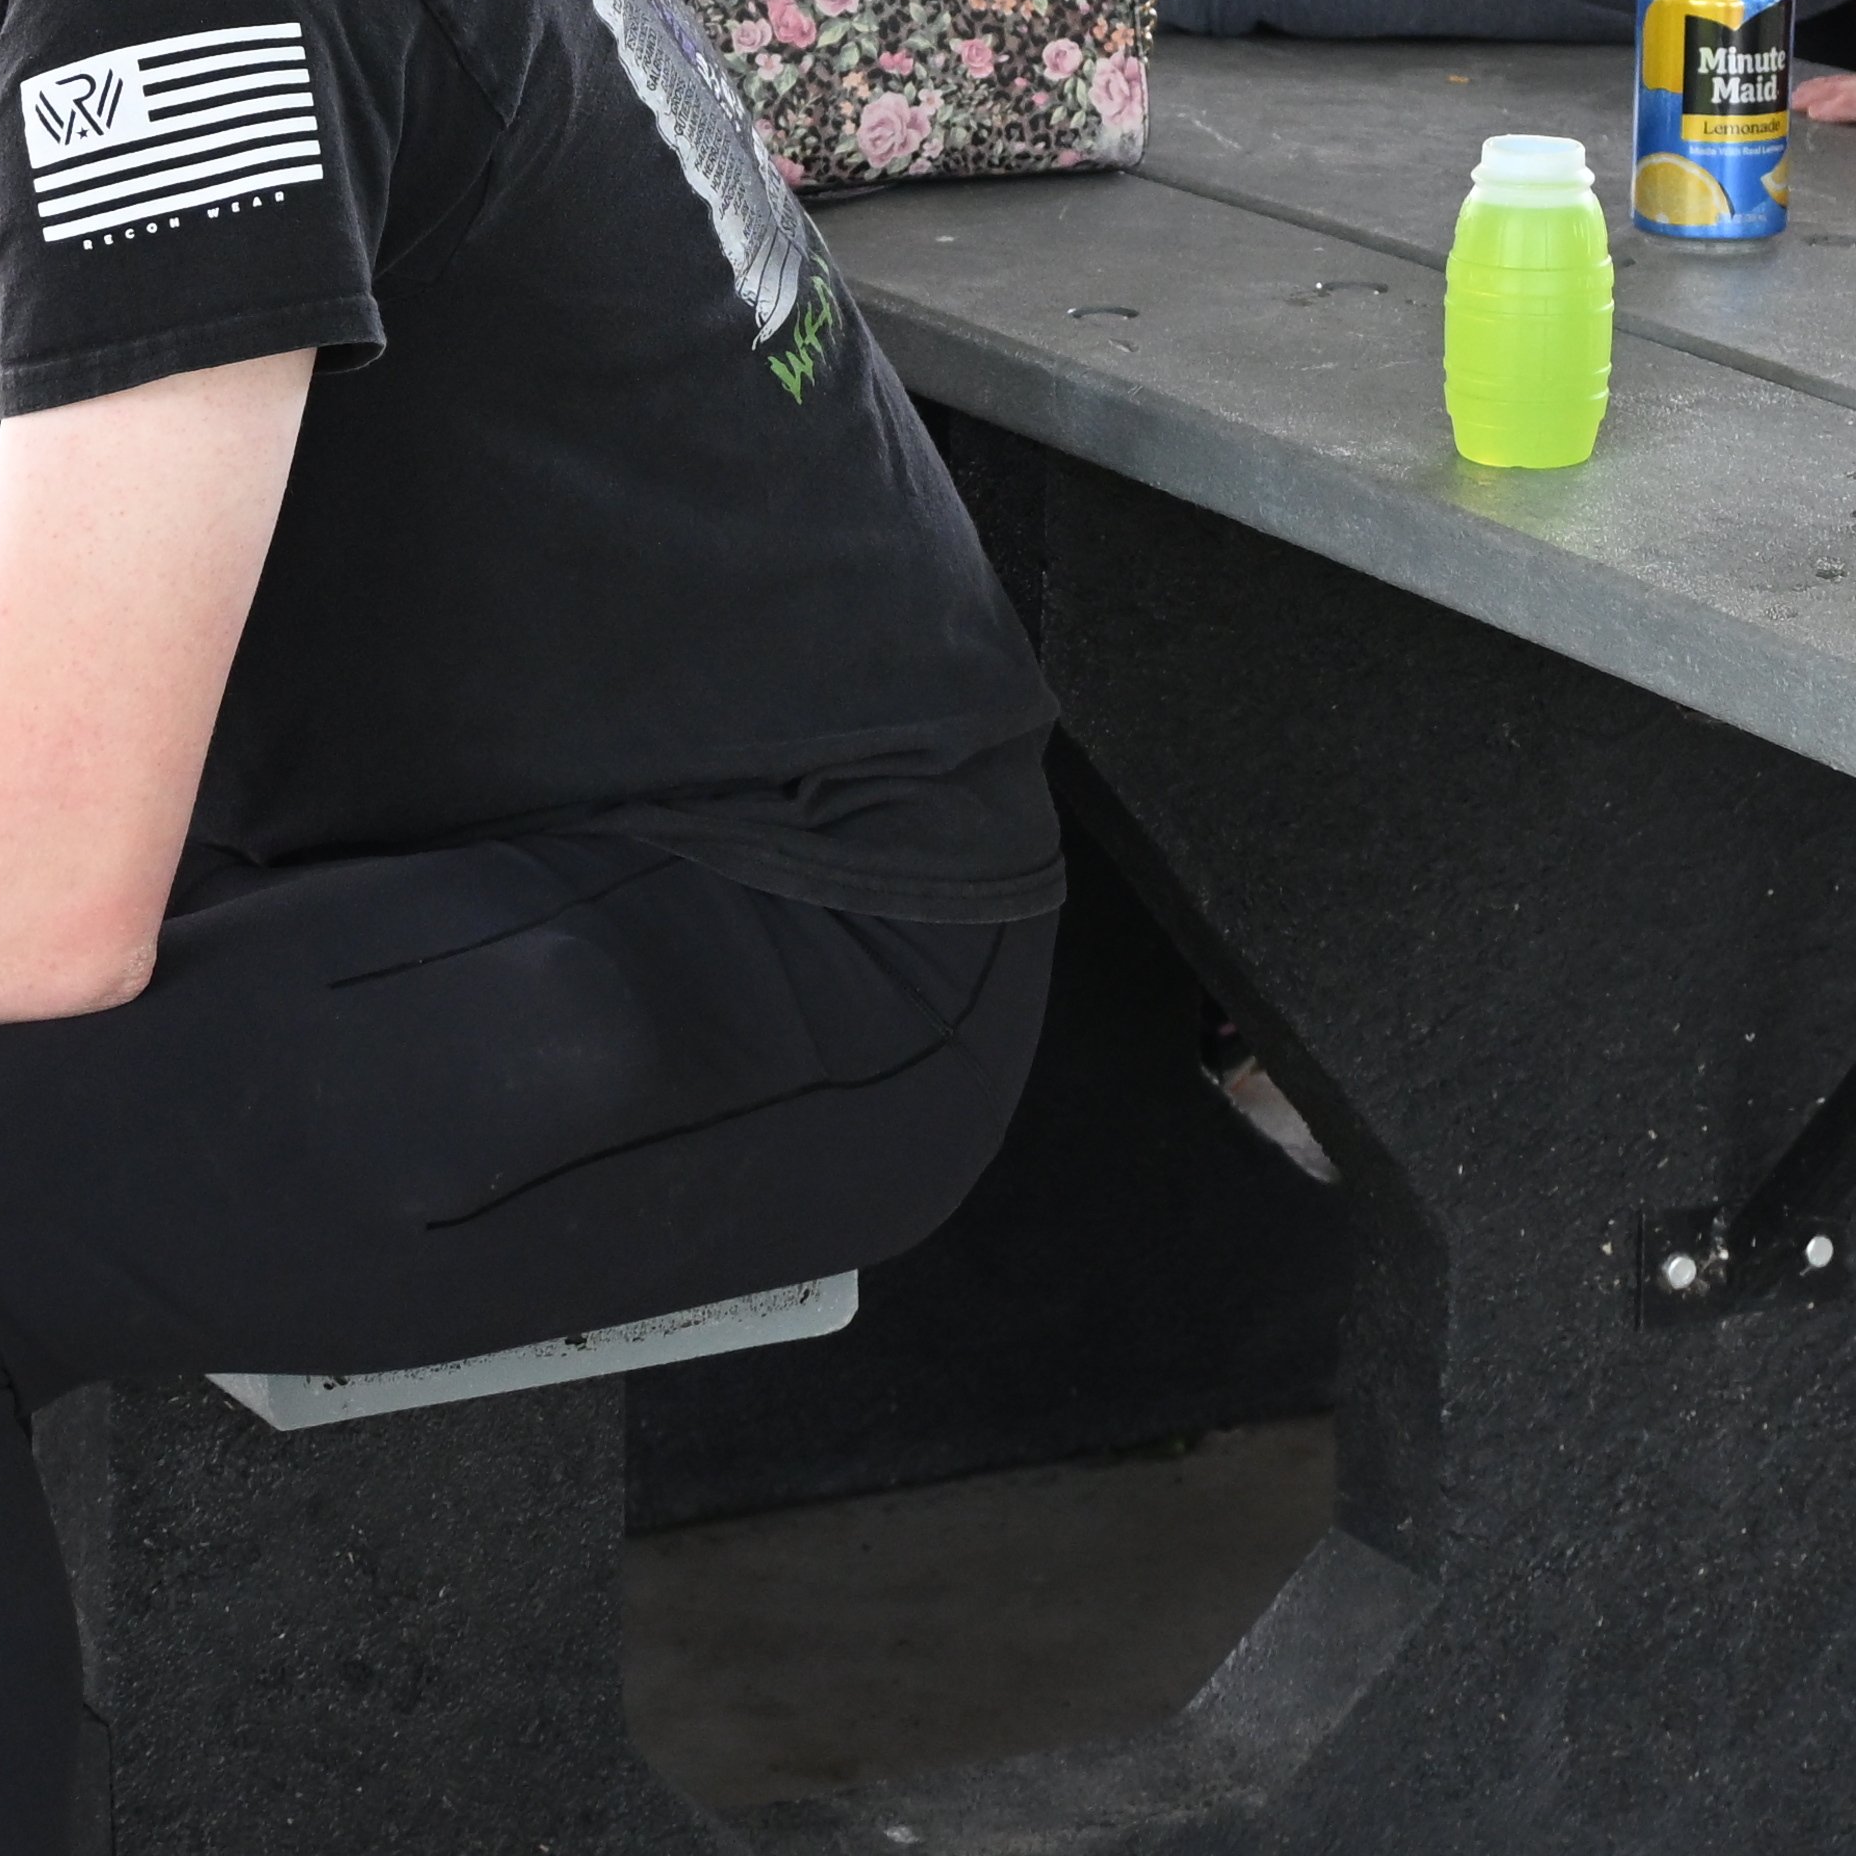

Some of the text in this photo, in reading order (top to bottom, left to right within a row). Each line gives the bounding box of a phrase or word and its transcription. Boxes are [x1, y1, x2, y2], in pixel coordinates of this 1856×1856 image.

[1697, 46, 1787, 75] Minute
[1710, 75, 1779, 105] Maid
[1702, 118, 1782, 137] Lemonade
[83, 190, 285, 251] RECON WEAR
